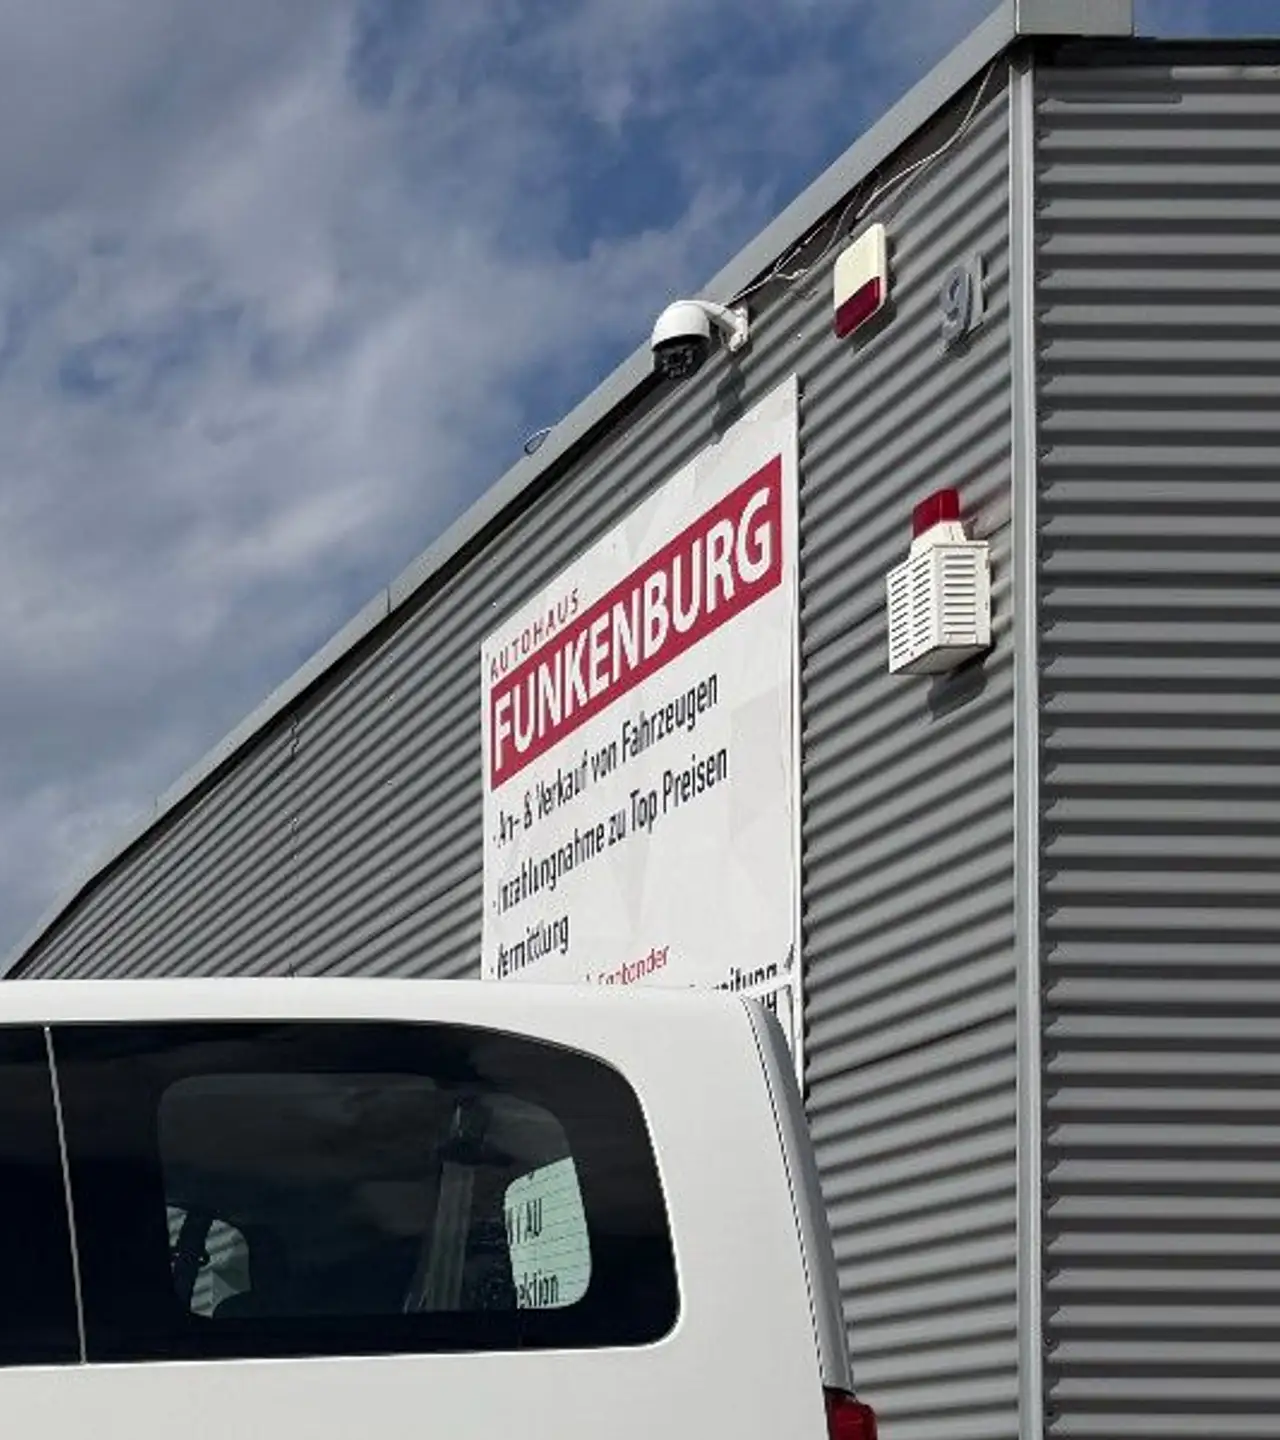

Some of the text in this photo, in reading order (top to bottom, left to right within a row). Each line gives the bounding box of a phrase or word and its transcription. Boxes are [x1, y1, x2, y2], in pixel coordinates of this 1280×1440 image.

[490, 588, 580, 682] AUTOHAUS
[494, 487, 772, 773] FUNKENBURG
[536, 749, 589, 820] Verkauf
[591, 740, 618, 784] von
[621, 673, 718, 763] Fahrzeugen
[497, 748, 728, 916] Inzahlungnahme zu Top Preisen
[497, 915, 570, 981] Vermittlung
[520, 1268, 559, 1308] ektion
